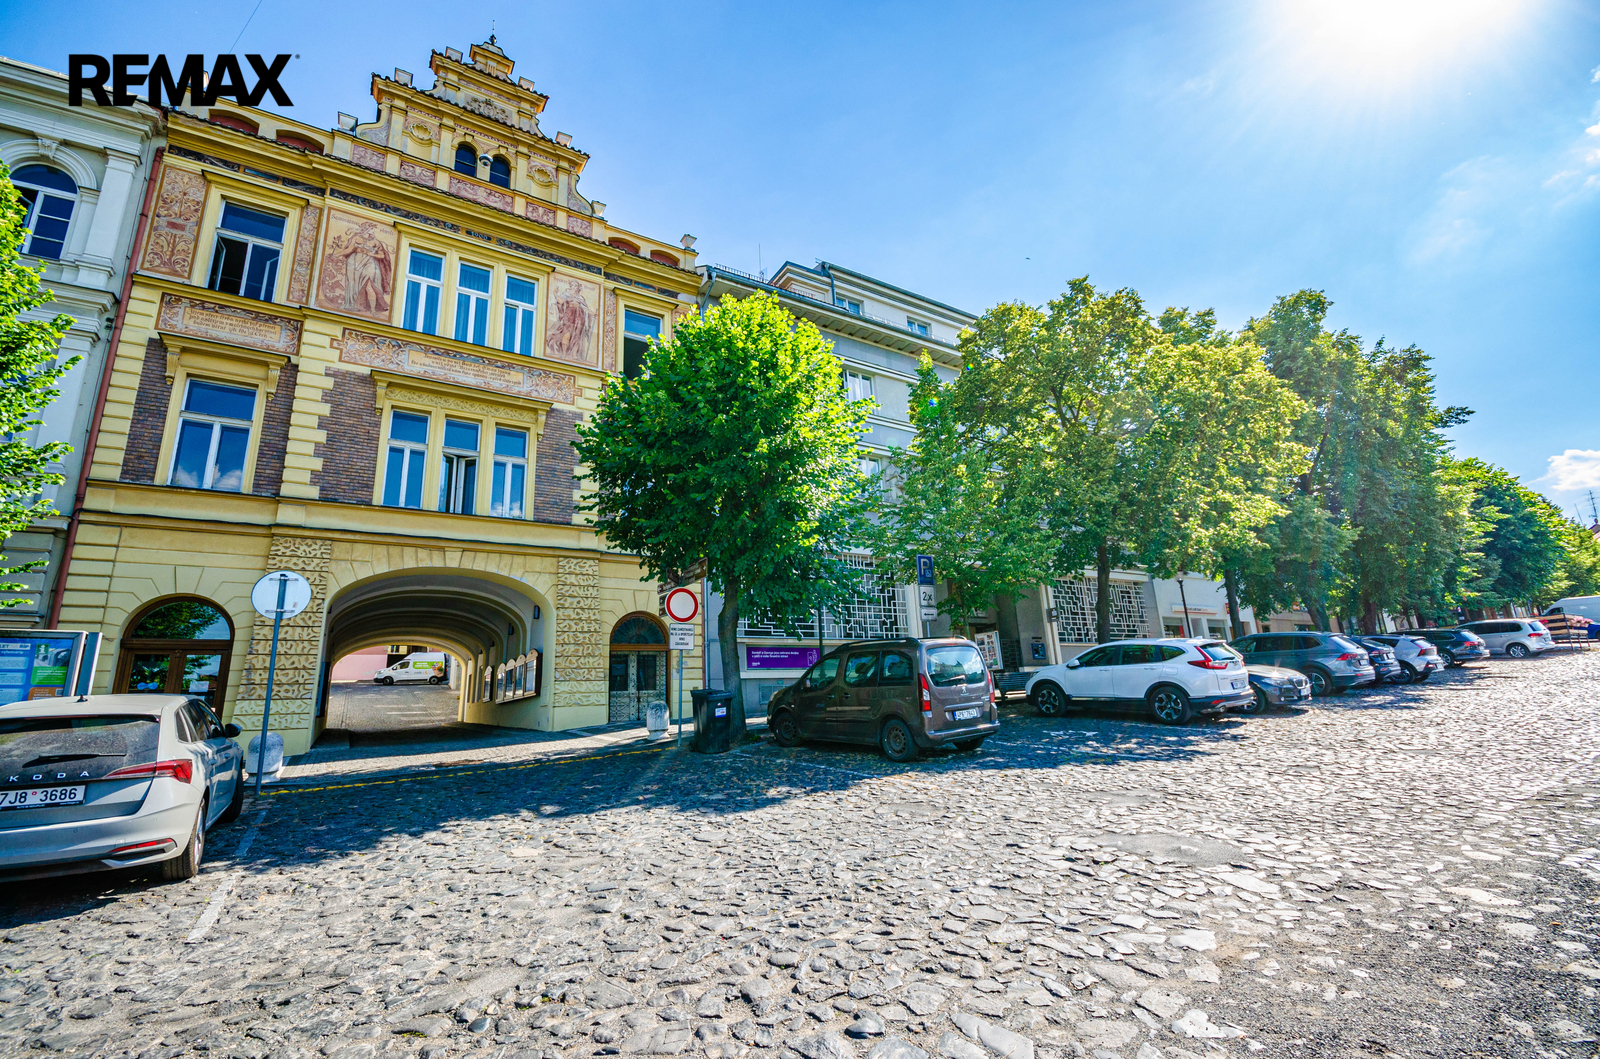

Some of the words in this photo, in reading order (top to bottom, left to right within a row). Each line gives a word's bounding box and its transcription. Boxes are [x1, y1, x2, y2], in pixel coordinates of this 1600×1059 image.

[920, 558, 930, 575] P
[922, 592, 932, 602] 2x
[0, 792, 28, 805] 7J8
[40, 788, 78, 802] 3686
